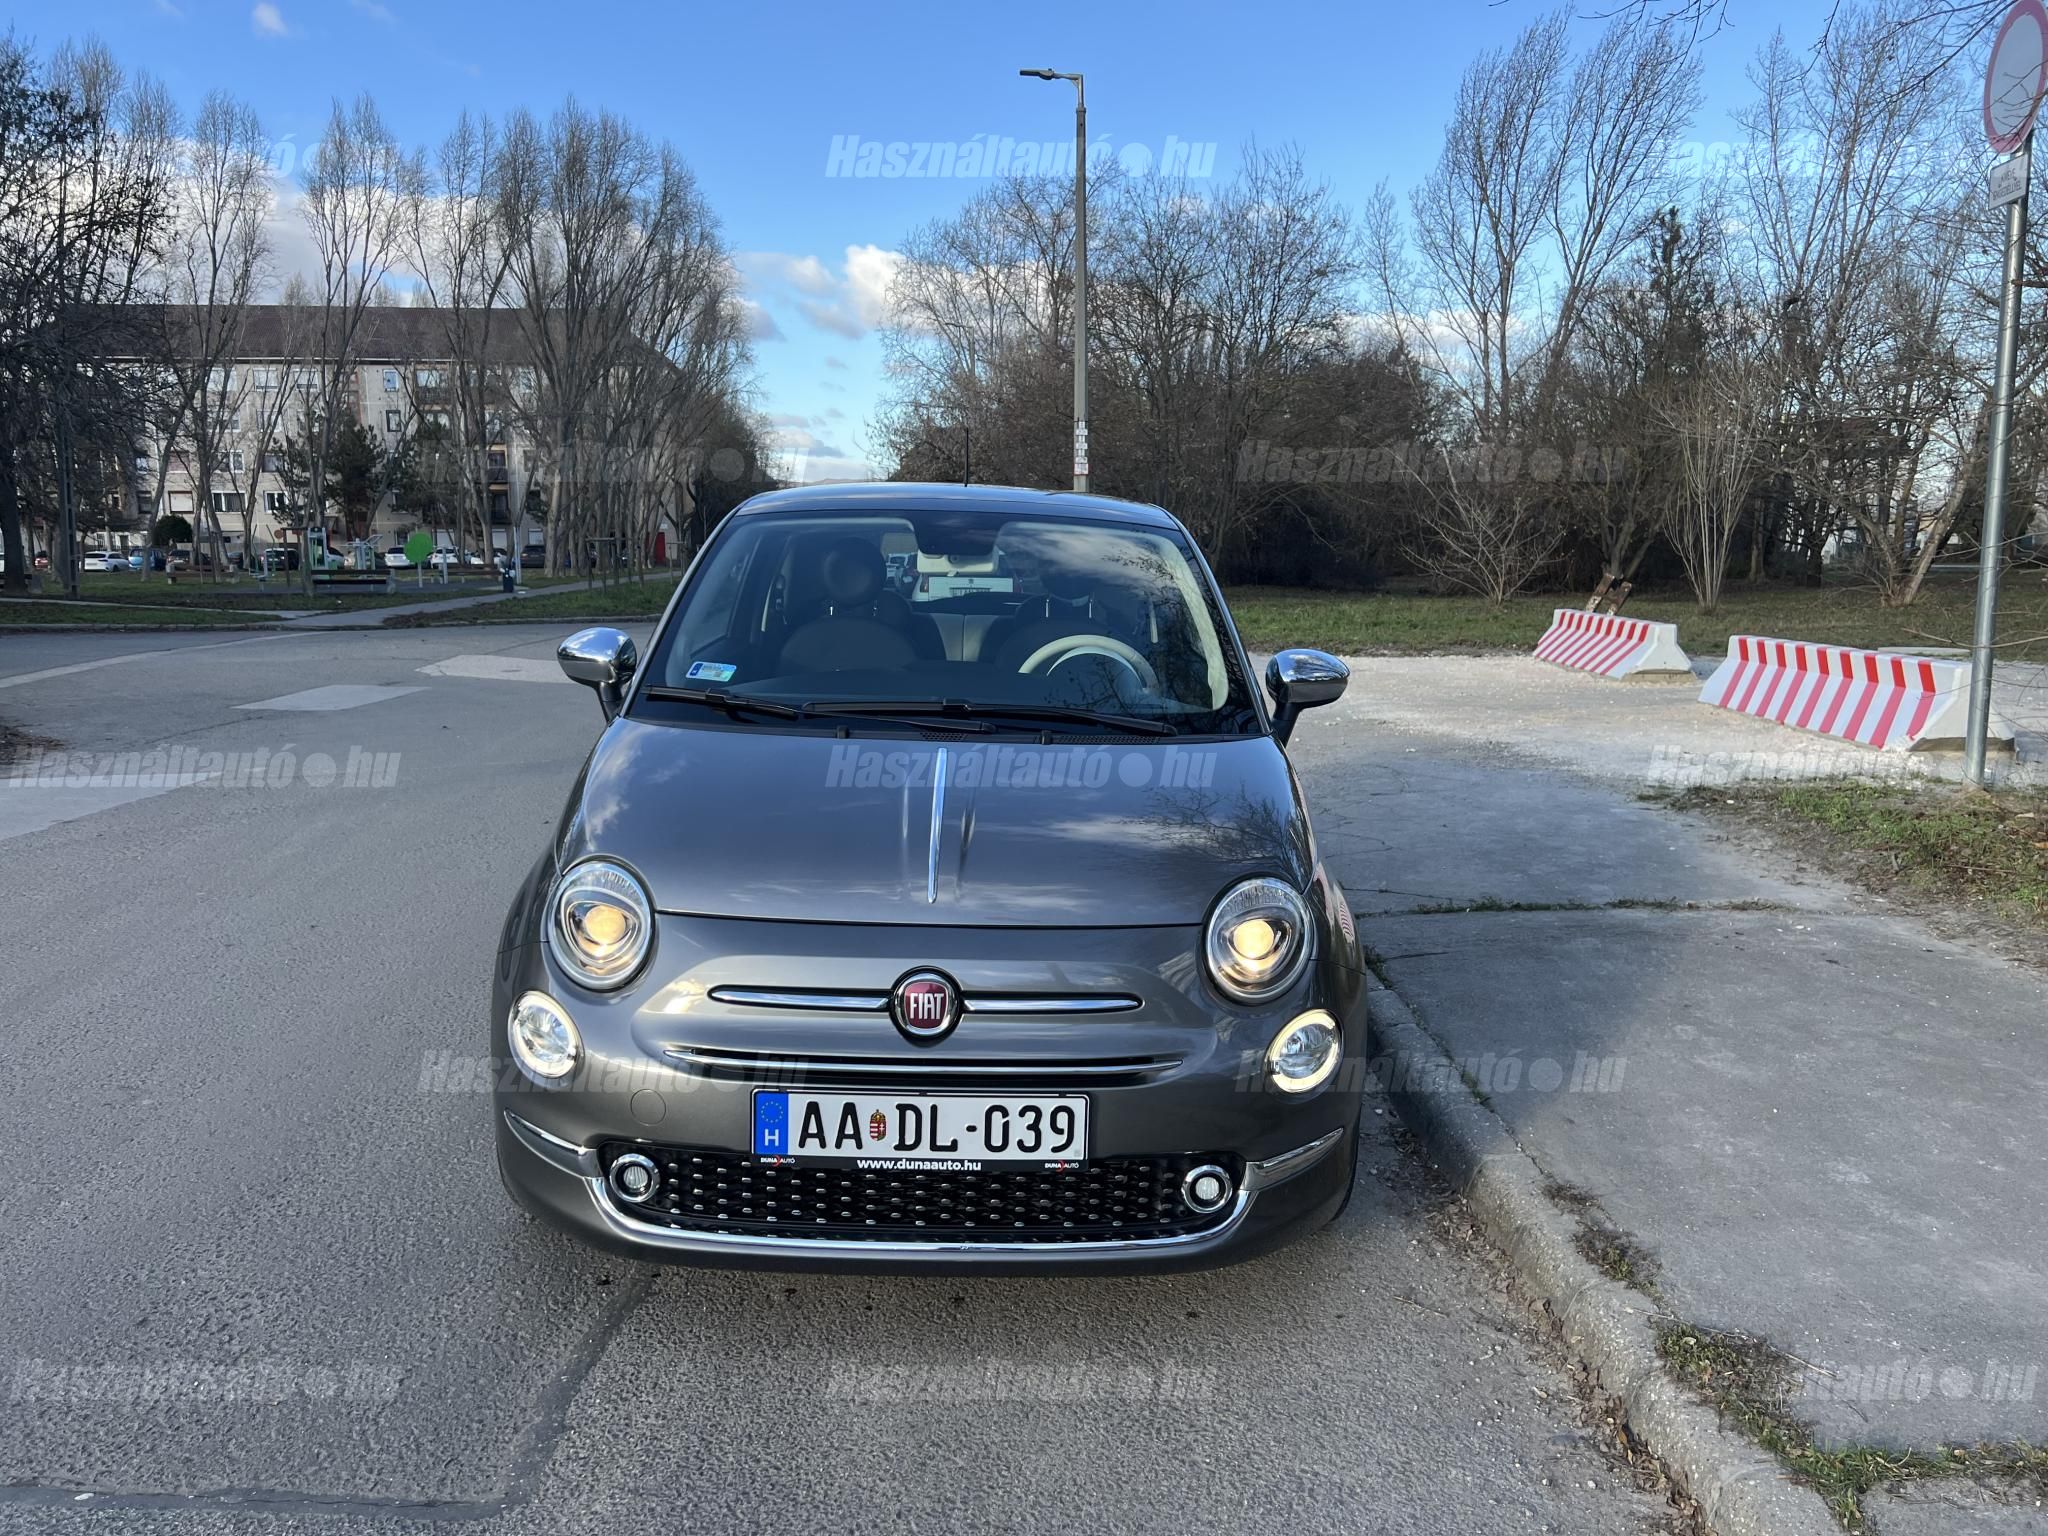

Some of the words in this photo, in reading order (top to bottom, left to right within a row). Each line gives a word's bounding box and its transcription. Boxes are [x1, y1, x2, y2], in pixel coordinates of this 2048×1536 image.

[909, 992, 945, 1020] FIAT
[764, 1128, 780, 1147] H
[857, 1158, 982, 1172] www.dunaauto.hu
